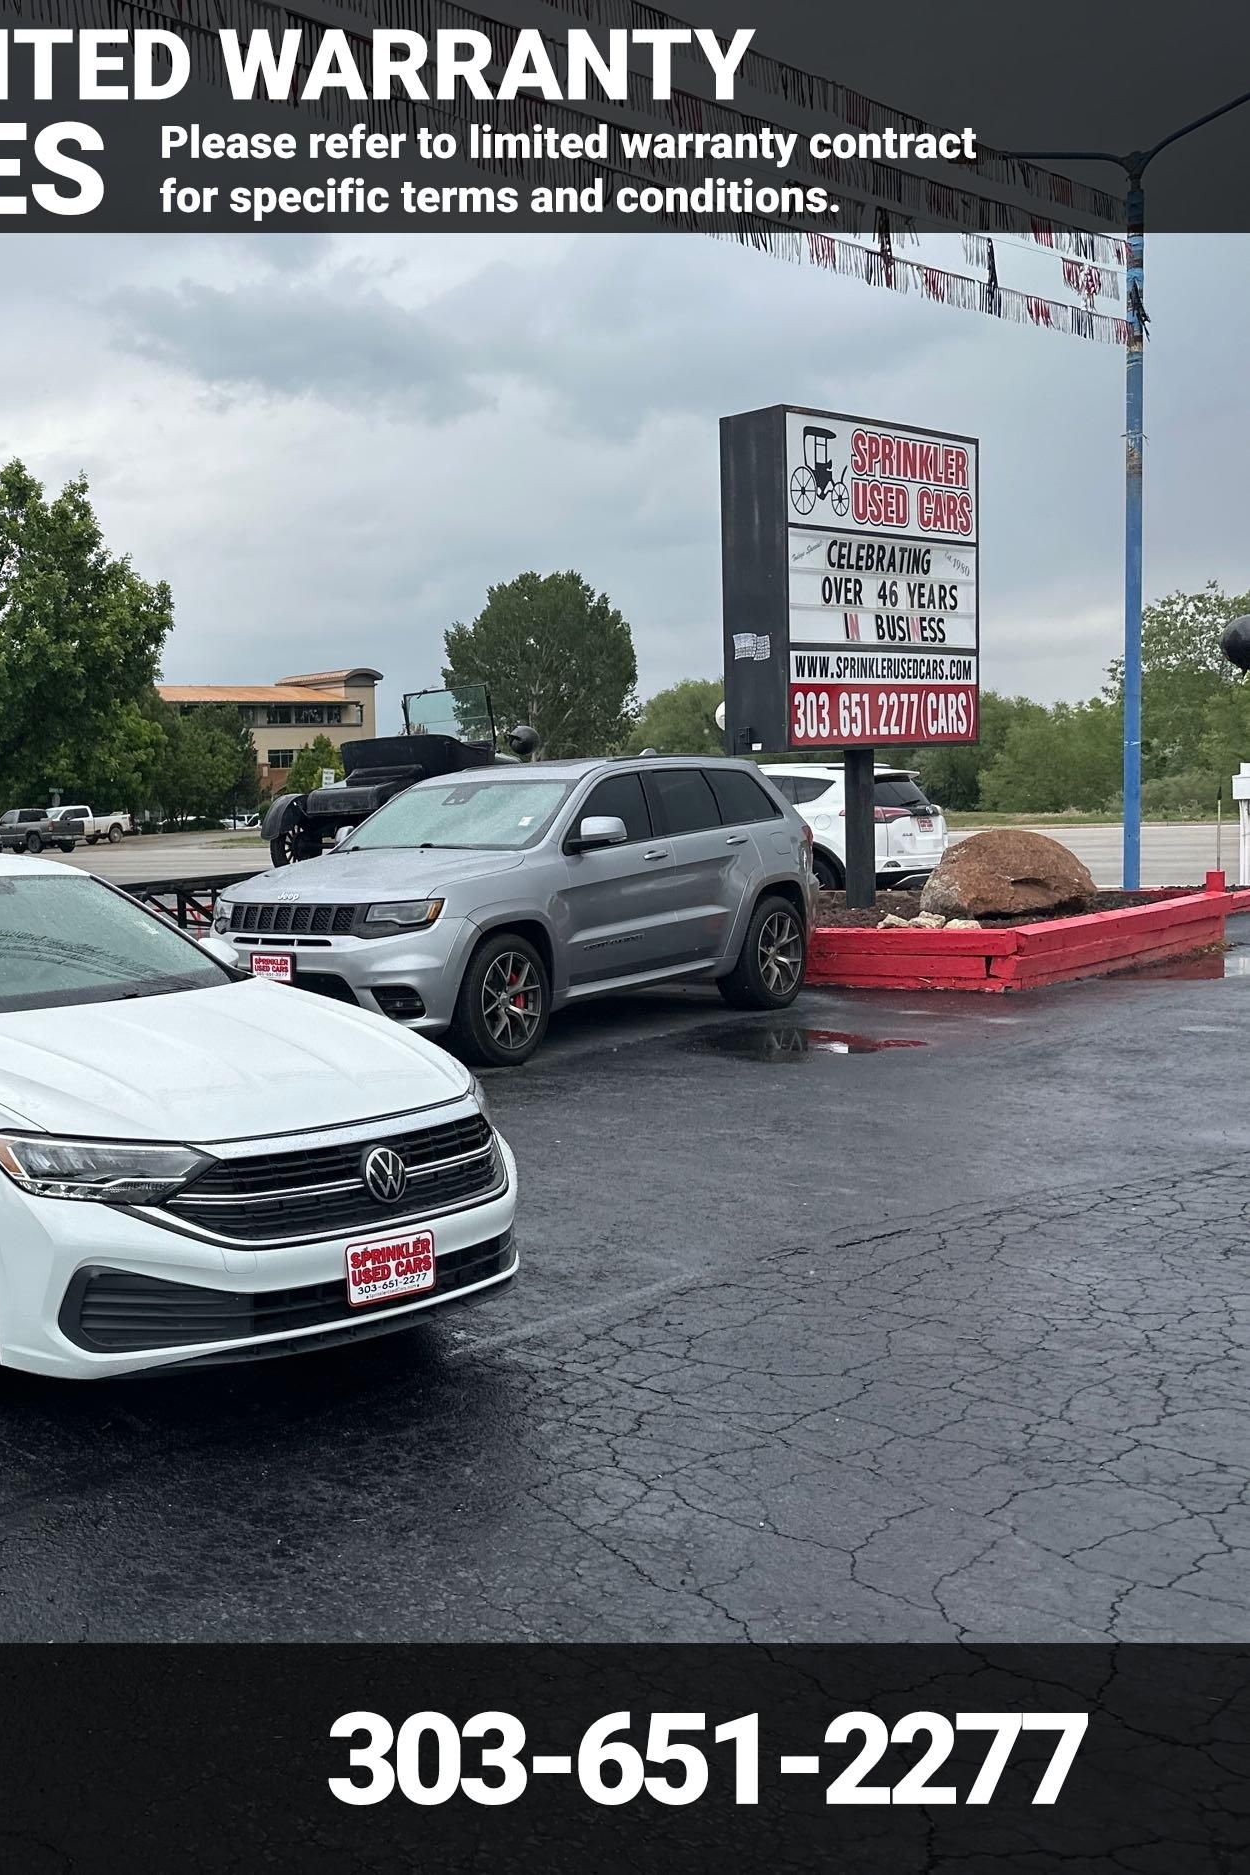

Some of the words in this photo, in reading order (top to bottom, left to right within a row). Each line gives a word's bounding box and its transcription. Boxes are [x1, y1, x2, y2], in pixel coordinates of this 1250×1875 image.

[851, 429, 968, 489] SPRINKLER
[852, 478, 909, 528] USED
[917, 486, 972, 536] CARS
[827, 540, 931, 575] CELEBRATING
[822, 576, 863, 605] OVER
[877, 580, 898, 608] 46
[907, 582, 958, 611] YEARS
[844, 613, 861, 641] IN
[875, 614, 946, 643] BUSINESS
[795, 655, 972, 681] WWW.SPRINKLERUSEDCARS.COM
[277, 891, 300, 902] Jeep
[254, 957, 288, 966] SPRINKLER
[351, 1238, 431, 1269] SPRINKLER
[351, 1264, 392, 1287] USED
[395, 1255, 432, 1278] CARS
[358, 1273, 427, 1295] 303-651-2277
